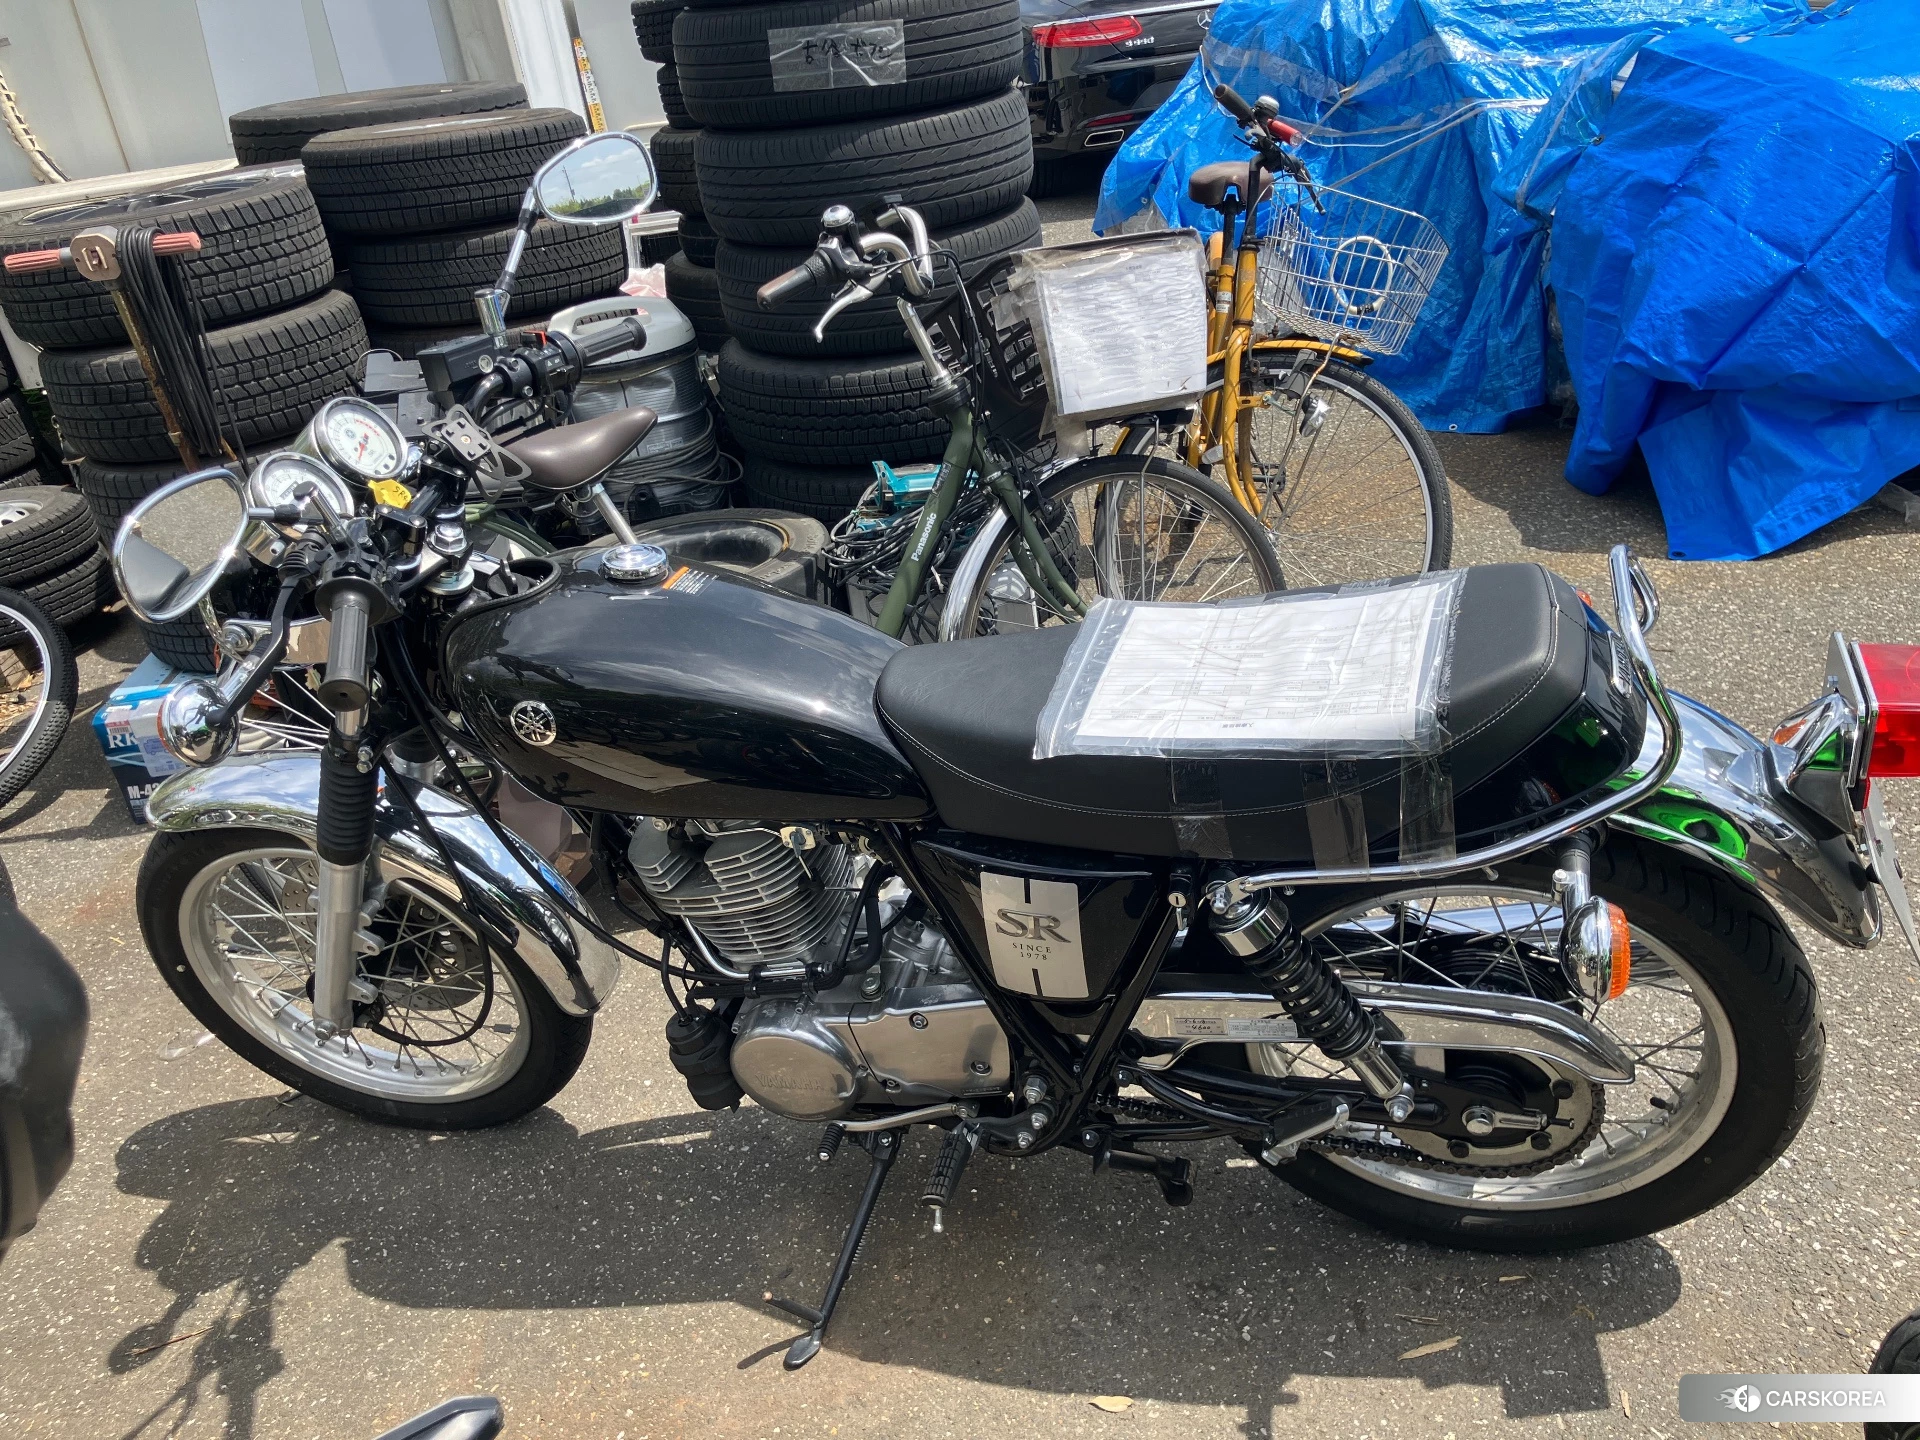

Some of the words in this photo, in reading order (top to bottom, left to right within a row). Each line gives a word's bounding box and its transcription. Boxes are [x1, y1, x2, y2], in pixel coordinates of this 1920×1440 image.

[911, 512, 937, 562] Panasonic
[995, 908, 1072, 943] SR
[1012, 942, 1052, 954] SINCE
[1020, 951, 1048, 961] 1978
